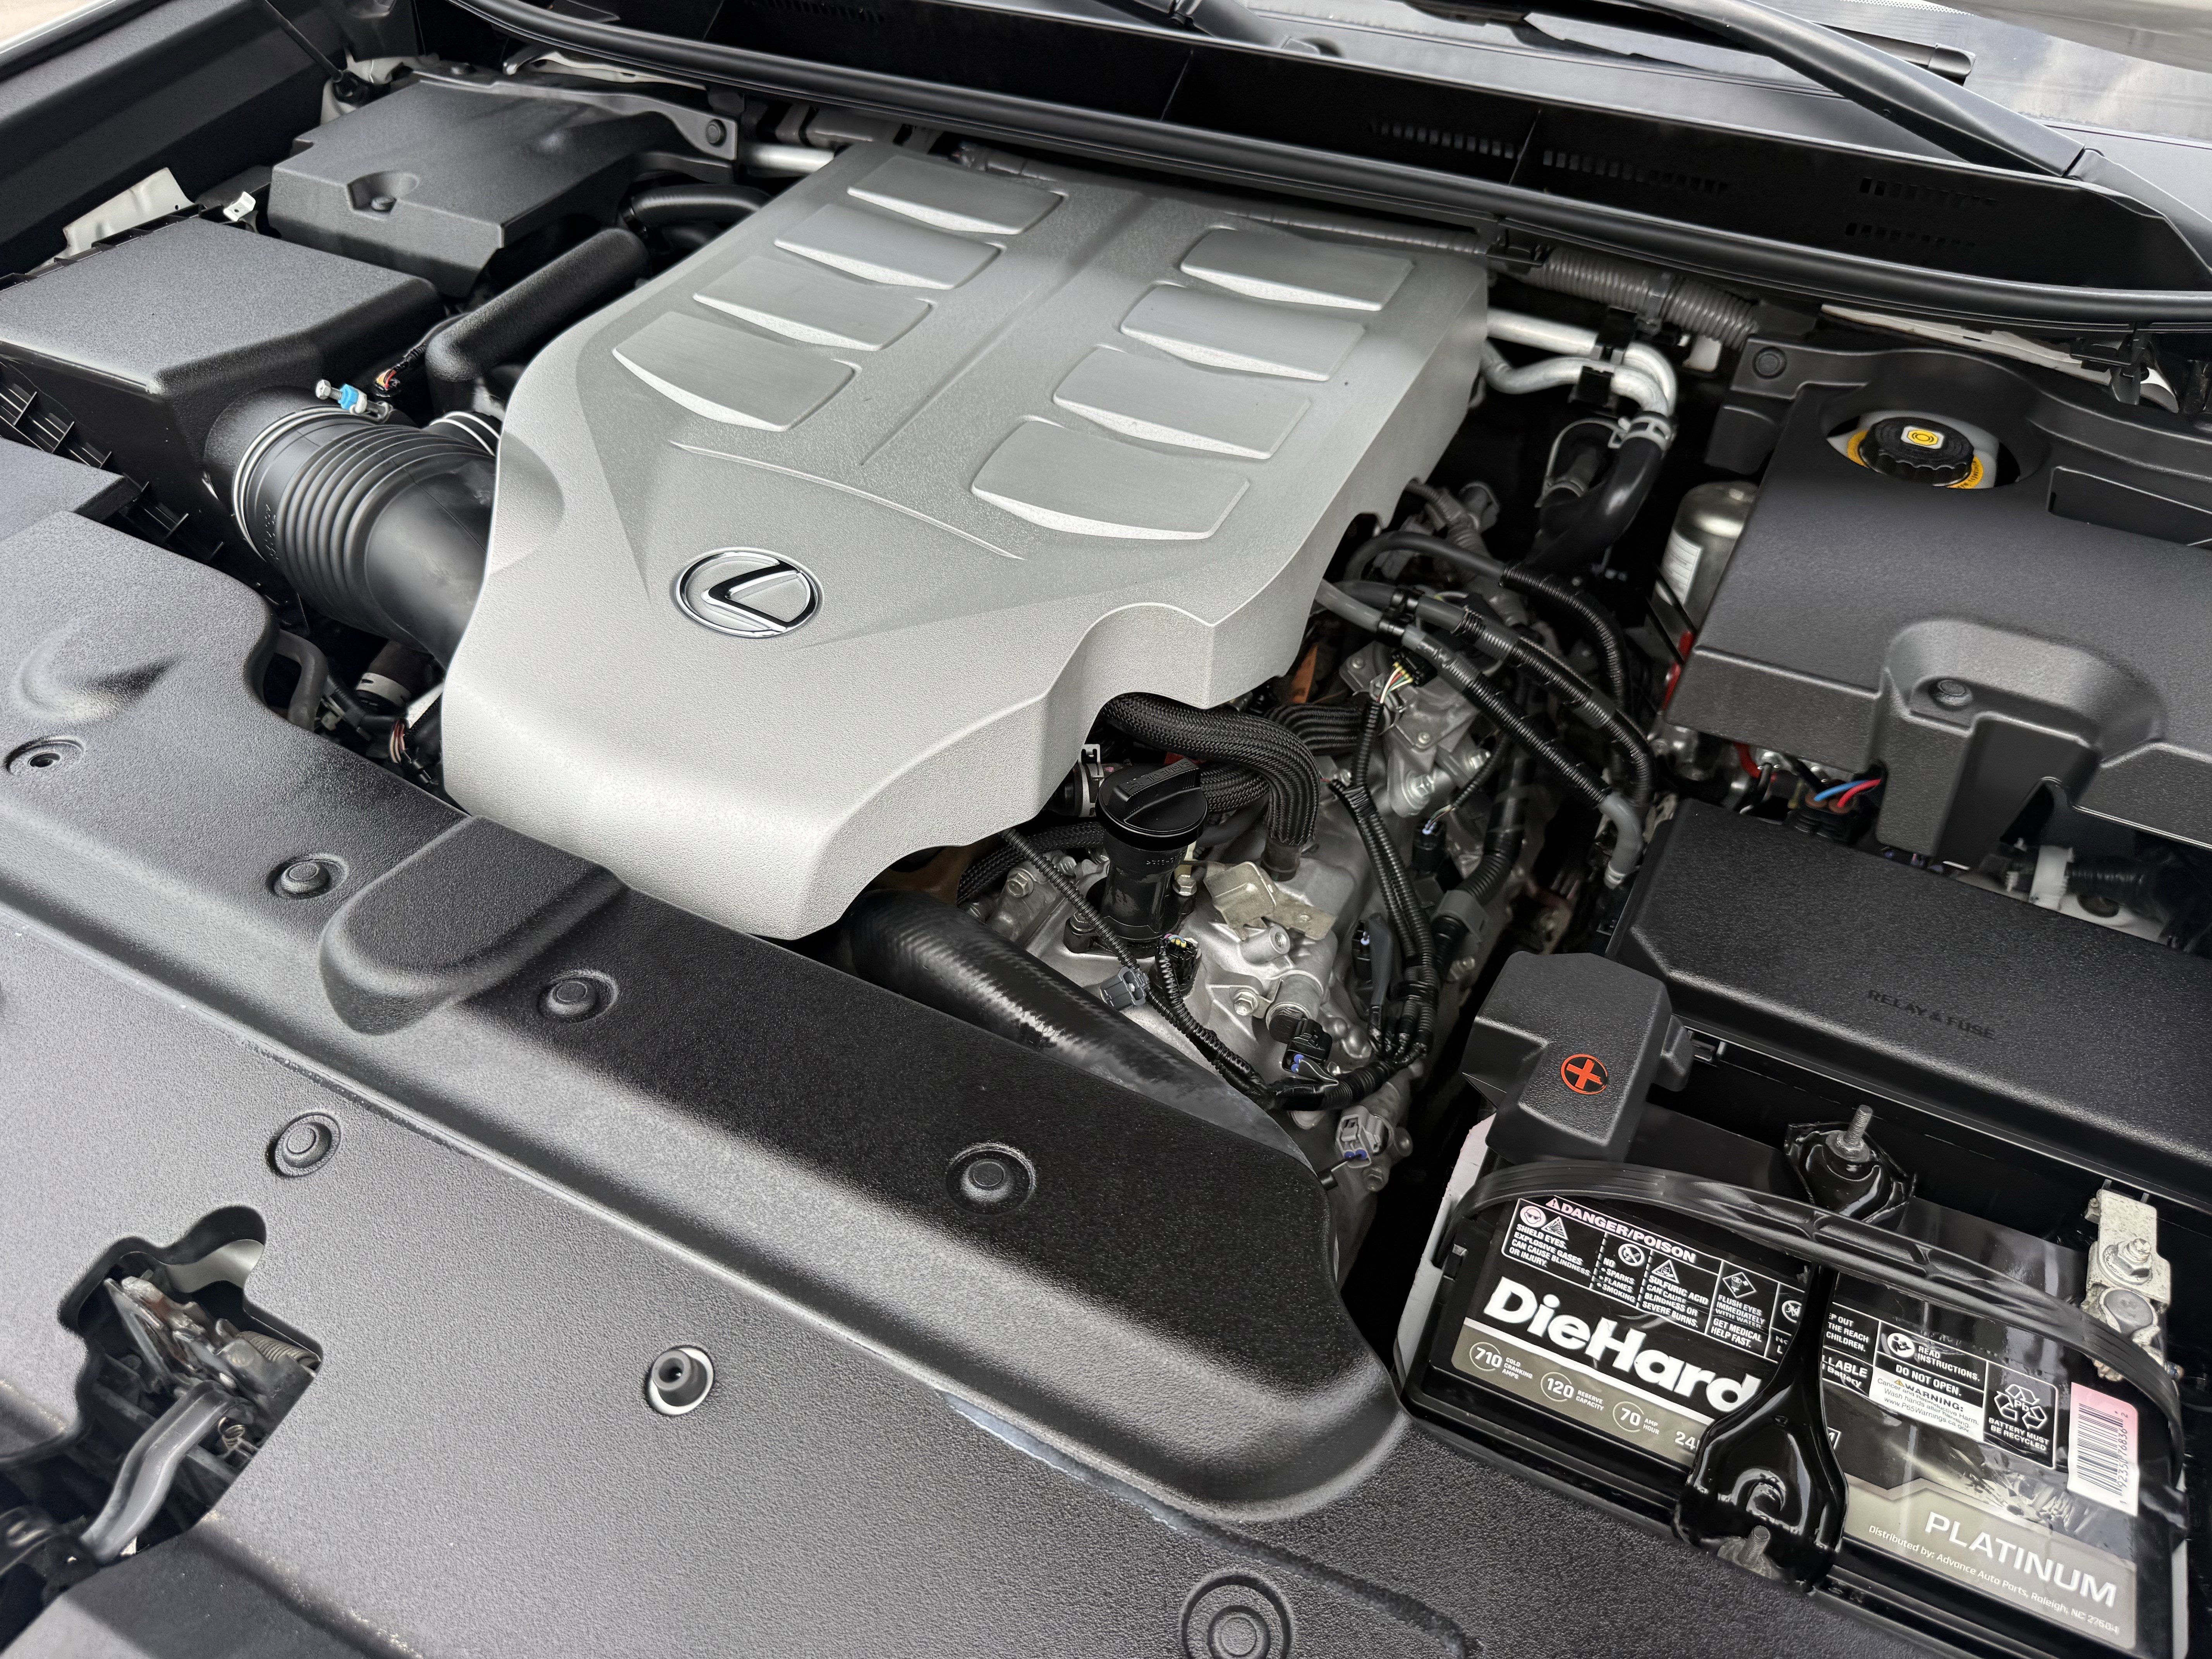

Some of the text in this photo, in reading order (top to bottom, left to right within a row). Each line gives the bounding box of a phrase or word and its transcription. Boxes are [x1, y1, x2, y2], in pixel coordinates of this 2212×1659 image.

[1867, 989, 1928, 1016] RELAY
[1946, 1016, 1995, 1039] FUSE
[1516, 1224, 1567, 1250] SHIELD EYES.
[1561, 1203, 1696, 1263] DANGER/POISON
[1509, 1247, 1547, 1267] OR INJURY.
[1511, 1238, 1591, 1276] CAN CAUSE BLINDNESS
[1514, 1231, 1583, 1266] EXPLOSIVE GASES
[1603, 1257, 1616, 1268] NO
[1604, 1276, 1633, 1293] FLAMES
[1606, 1268, 1635, 1285] SPARKS
[1602, 1283, 1636, 1303] SMOKING
[1647, 1284, 1686, 1304] CAN CAUSE
[1648, 1275, 1709, 1305] SULFURIC ACID
[1642, 1301, 1698, 1328] SEVERE BURNS.
[1644, 1292, 1698, 1317] BLINDNESS OR
[1715, 1308, 1735, 1319] WITH
[1716, 1301, 1765, 1325] IMMEDIATELY
[1718, 1294, 1762, 1316] FLUSH EYES
[1713, 1318, 1762, 1342] GET MEDICAL
[1838, 1316, 1854, 1327] OUT
[1711, 1326, 1751, 1348] HELP FAST.
[1826, 1331, 1866, 1352] CHILDREN.
[1828, 1322, 1869, 1343] THE REACH
[1475, 1347, 1503, 1368] 710
[1484, 1276, 1761, 1422] DieHard
[1918, 1346, 1941, 1359] READ
[1504, 1363, 1533, 1379] CRANKING
[1506, 1357, 1521, 1367] COLD
[1917, 1353, 1980, 1381] INSTRUCTIONS.
[1502, 1368, 1519, 1379] AMPS
[1827, 1365, 1862, 1390] Battery
[1896, 1364, 1961, 1396] DO NOT OPEN.
[1547, 1378, 1574, 1398] 120
[1577, 1390, 1603, 1405] RESERVE
[1884, 1388, 1903, 1400] Wash
[1905, 1395, 1925, 1407] hands
[1905, 1383, 1963, 1412] WARNING:
[1576, 1396, 1604, 1411] CAPACITY
[2014, 1399, 2029, 1413] Pb
[1620, 1407, 1641, 1426] 70
[1644, 1418, 1658, 1427] AMP
[1959, 1413, 1979, 1425] Harm.
[1643, 1424, 1659, 1435] HOUR
[1989, 1417, 2049, 1445] BATTERY MUST
[1990, 1425, 2046, 1451] BE RECYCLED
[1925, 1511, 2116, 1607] PLATINUM
[1869, 1525, 1920, 1552] Distributed
[1920, 1546, 1935, 1558] by:
[1936, 1554, 1976, 1575] Advance
[1977, 1570, 2001, 1585] Auto
[2002, 1580, 2028, 1598] Parts,
[2031, 1592, 2069, 1614] Raleigh,
[2071, 1608, 2086, 1620] NC
